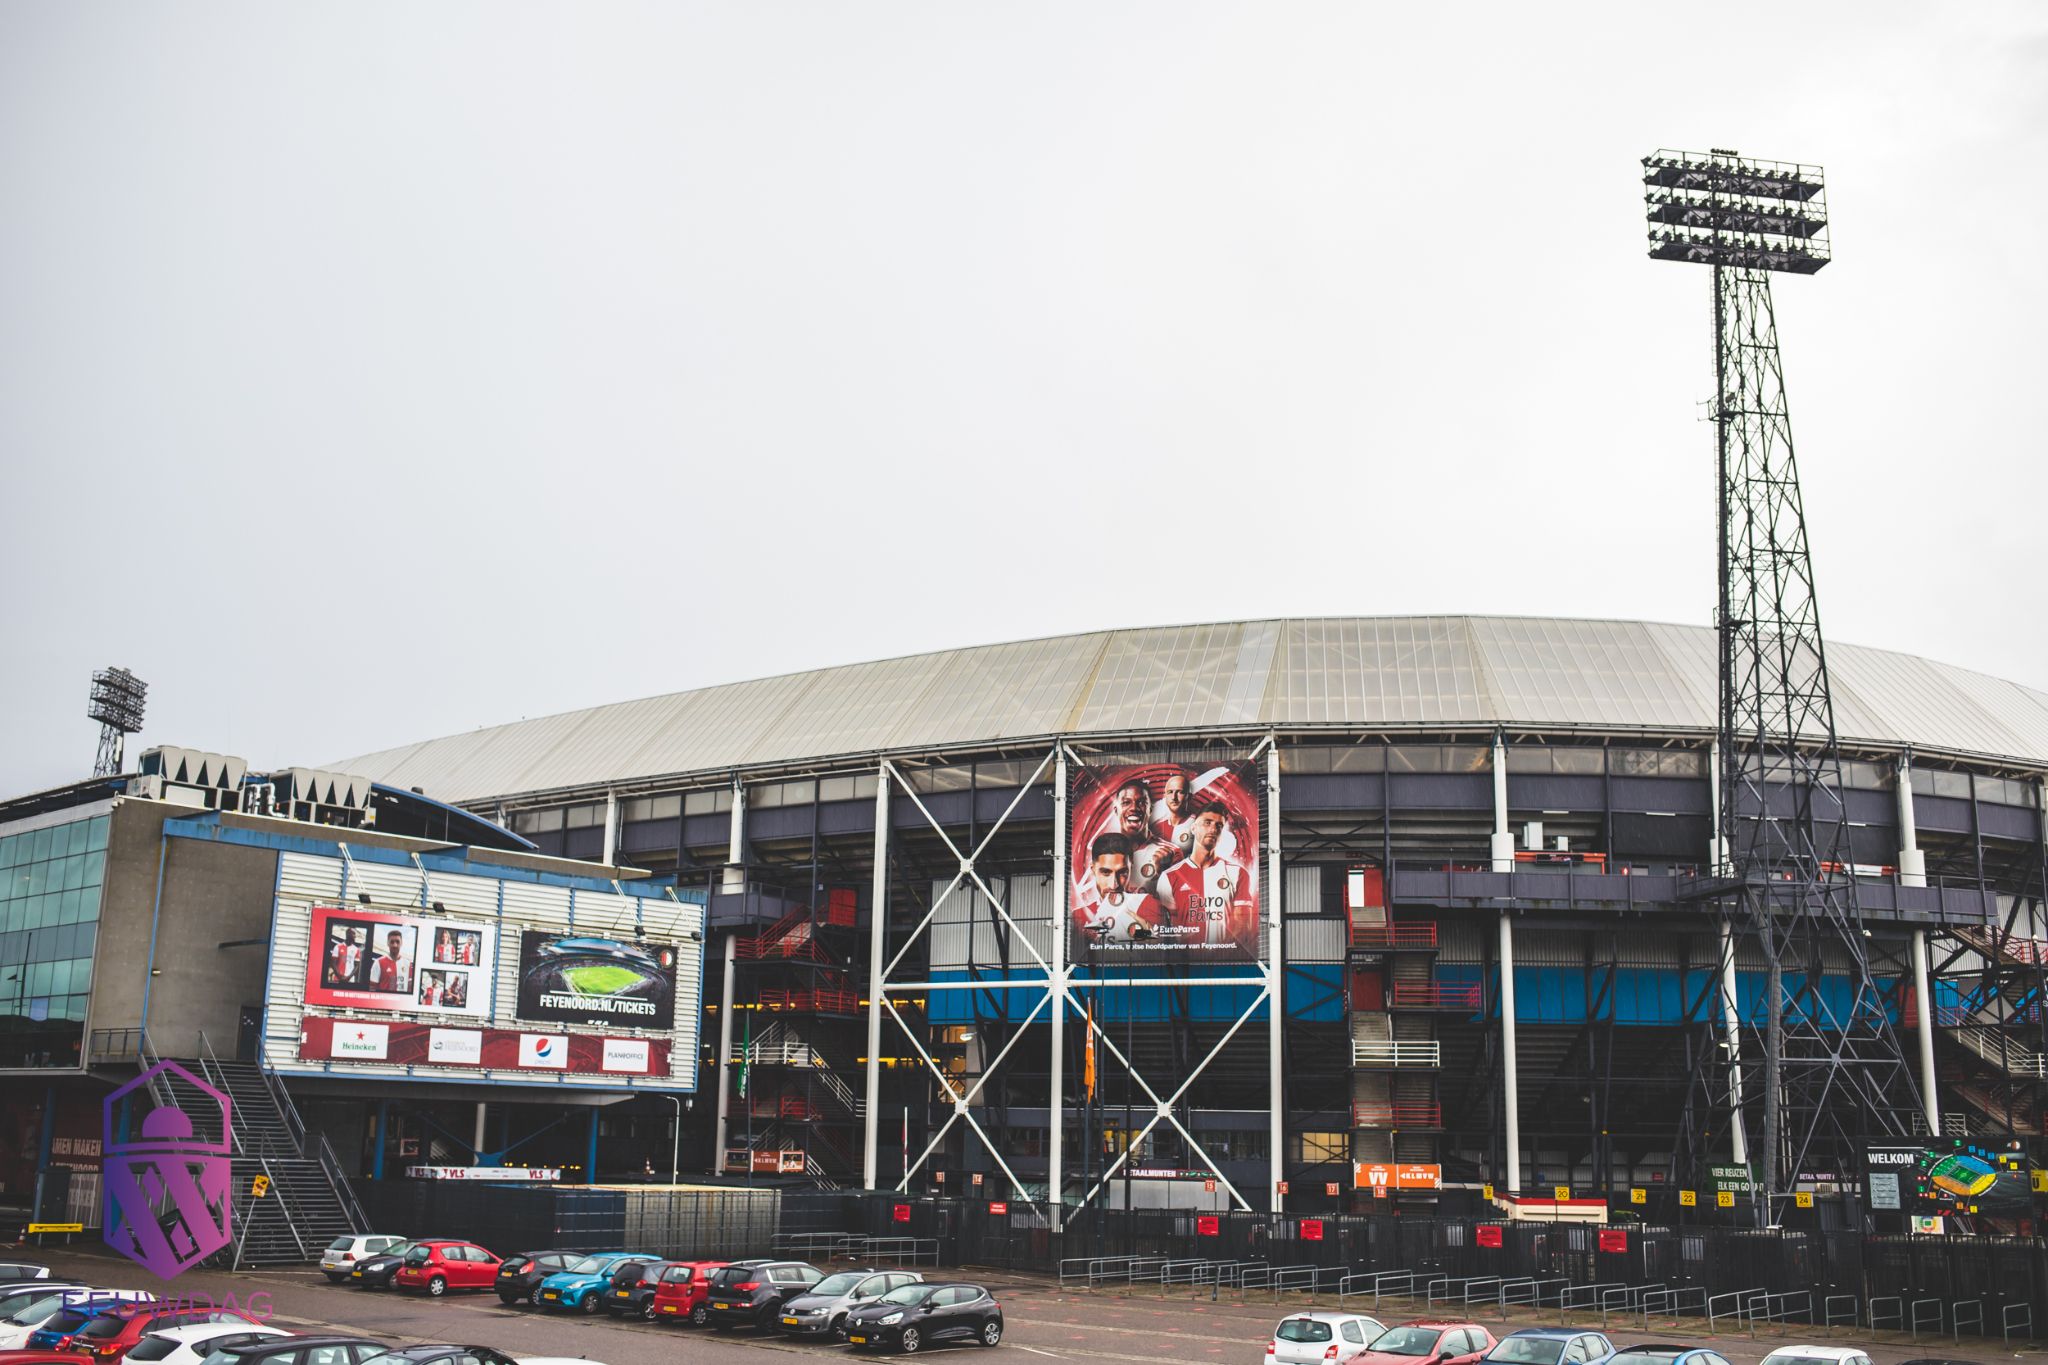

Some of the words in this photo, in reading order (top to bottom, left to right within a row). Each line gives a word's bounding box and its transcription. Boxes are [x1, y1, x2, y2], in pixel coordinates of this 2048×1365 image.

[1189, 894, 1224, 909] Euro
[1159, 925, 1200, 934] EuroParcs
[1145, 942, 1187, 951] hoofdpartner
[1201, 942, 1238, 951] Feyenoord.
[539, 994, 656, 1016] FEYENOORD.NL/TICKETS
[342, 1041, 377, 1051] Heineken
[73, 1139, 102, 1157] MAKEN
[1867, 1152, 1915, 1165] WELKOM
[450, 1169, 465, 1178] VLS
[529, 1170, 544, 1179] VLS
[1711, 1167, 1725, 1177] VIER
[1280, 1183, 1287, 1191] 16
[1717, 1181, 1728, 1191] ELK
[1728, 1181, 1740, 1191] EEN
[2032, 1177, 2040, 1190] U
[1328, 1185, 1335, 1193] 17
[1683, 1194, 1693, 1202] 22
[1720, 1195, 1730, 1203] 23
[1798, 1196, 1809, 1204] 24
